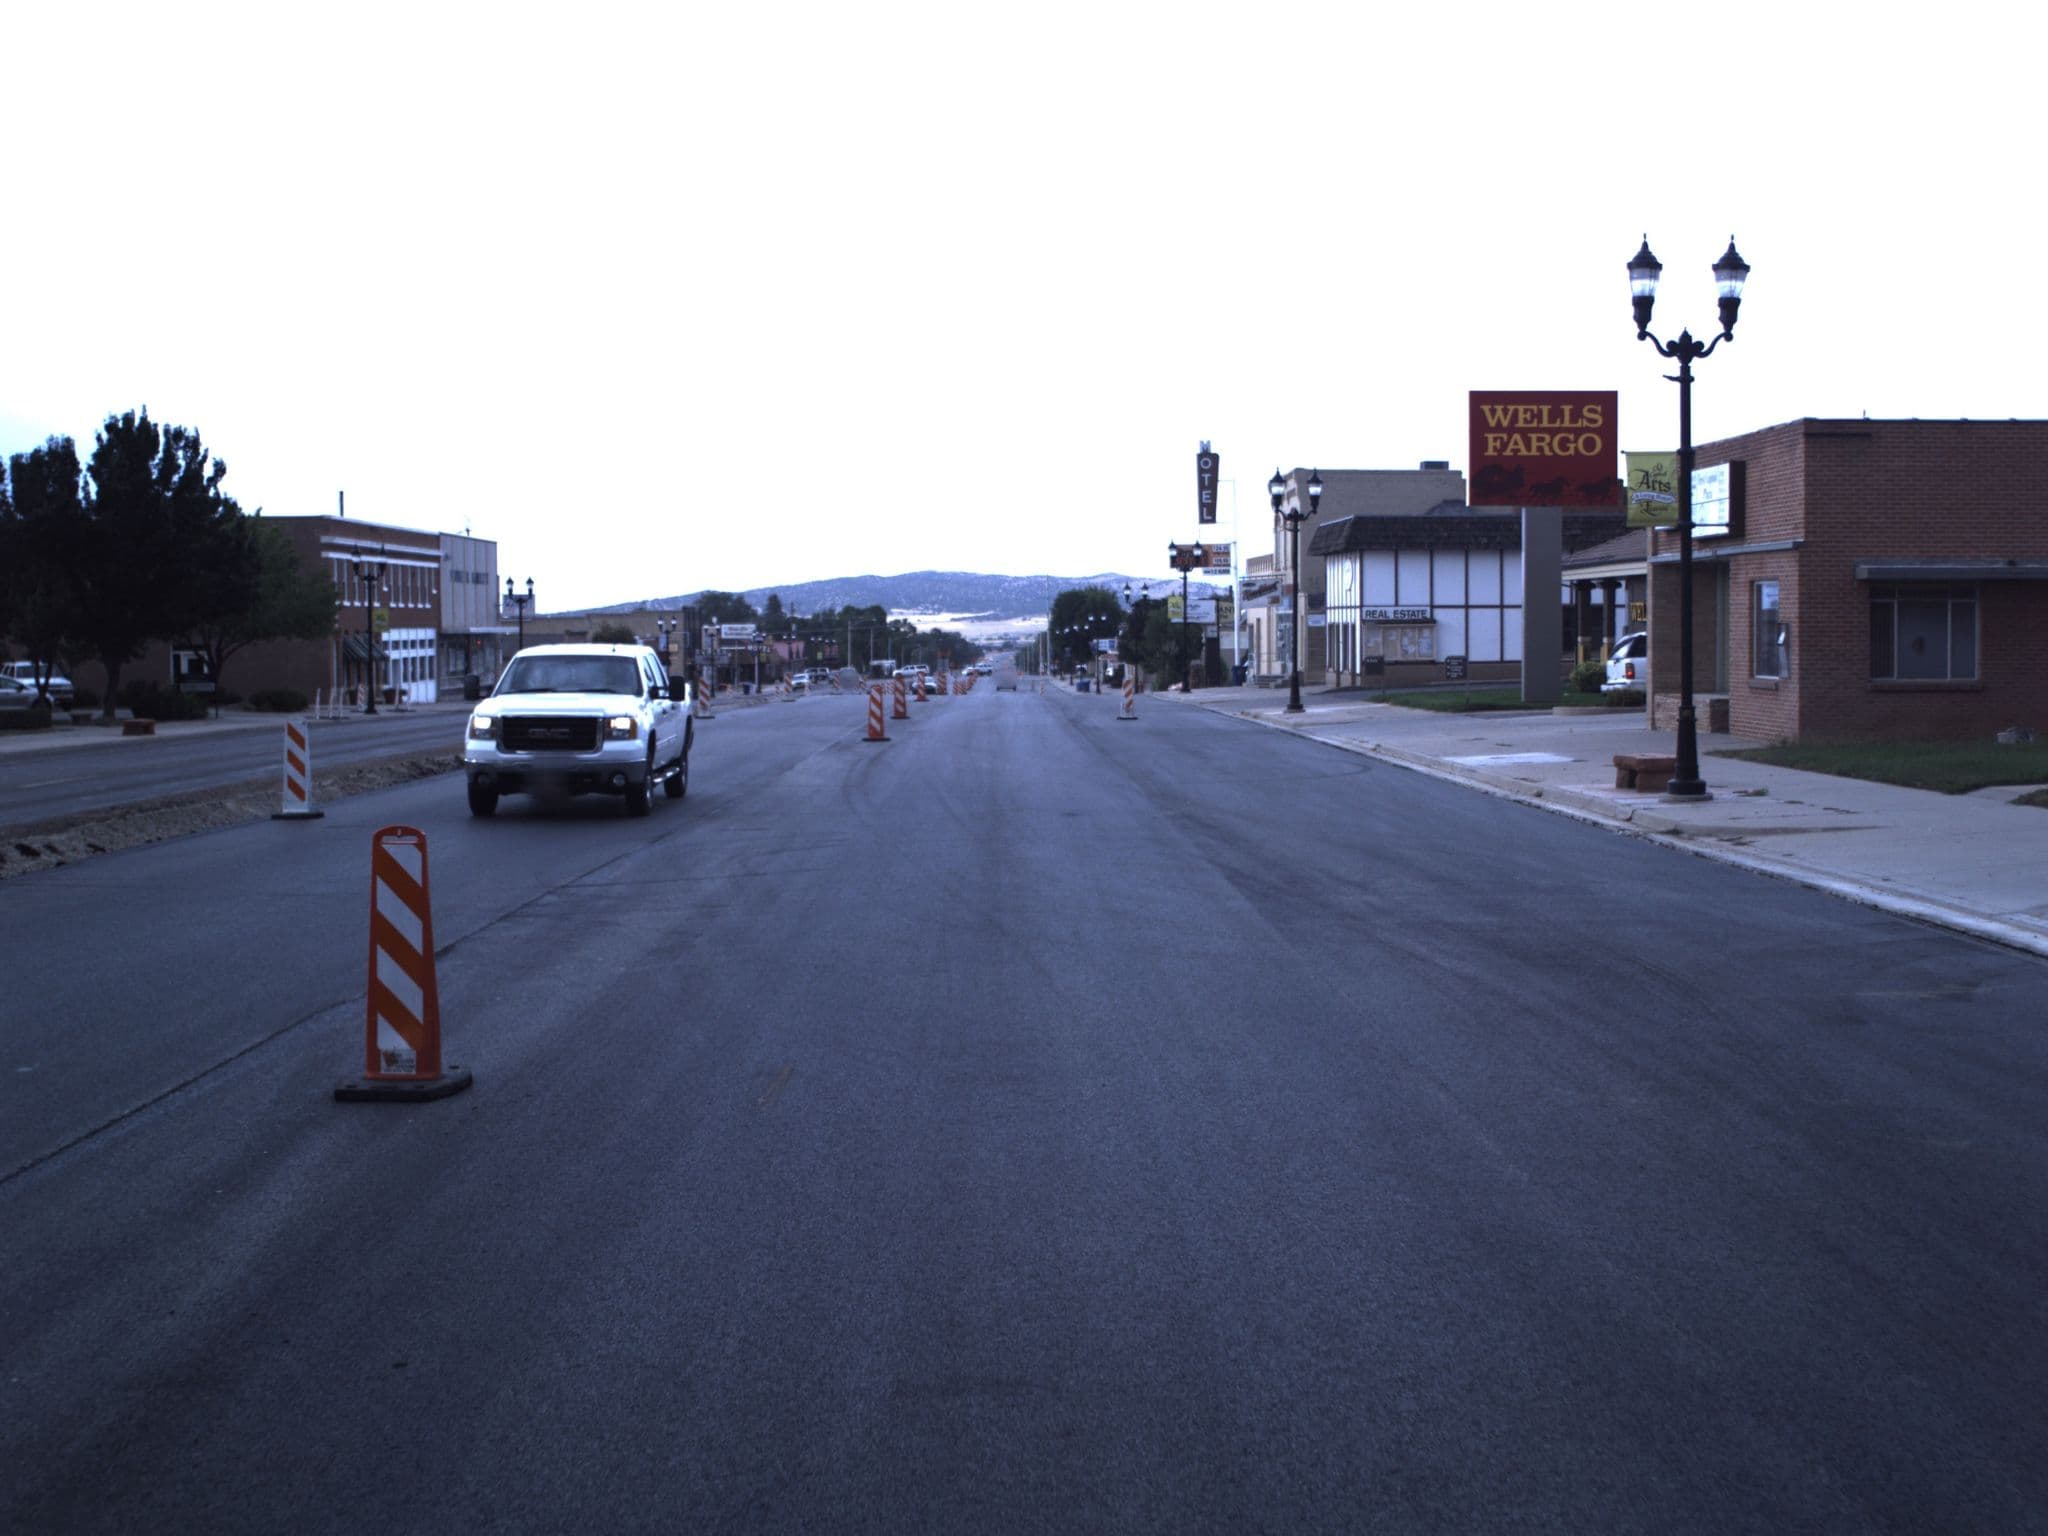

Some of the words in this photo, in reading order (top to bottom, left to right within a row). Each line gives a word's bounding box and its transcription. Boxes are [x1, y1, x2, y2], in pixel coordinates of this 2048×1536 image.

[1480, 404, 1604, 429] WELLS
[1484, 432, 1603, 457] FARGO
[1199, 440, 1212, 520] MOTEL
[1630, 468, 1671, 494] Arts
[1364, 609, 1390, 619] REAL
[1393, 608, 1428, 619] ESTATE
[528, 727, 570, 739] GMC
